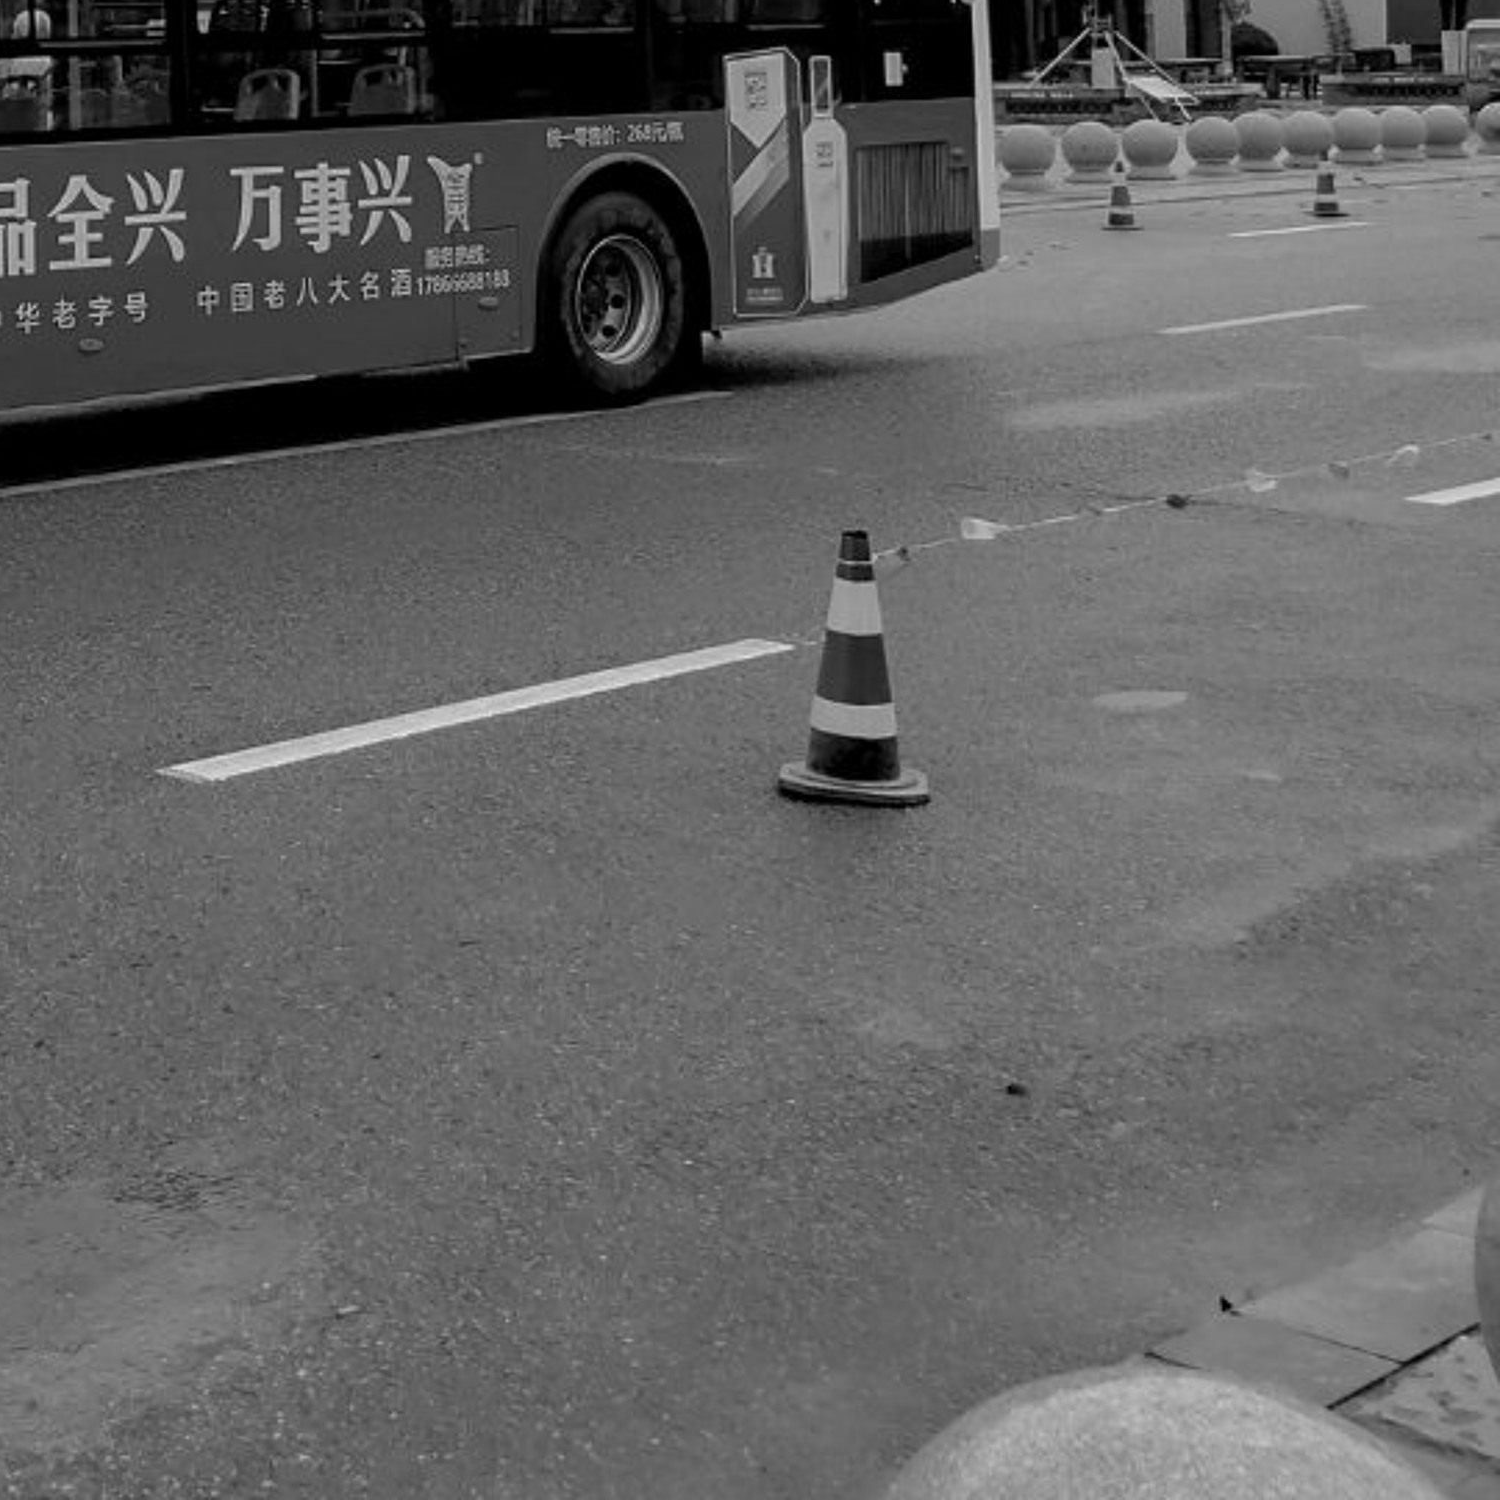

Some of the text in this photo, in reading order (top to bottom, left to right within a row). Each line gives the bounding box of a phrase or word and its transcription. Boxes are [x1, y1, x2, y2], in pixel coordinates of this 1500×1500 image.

[230, 154, 412, 254] 万事兴
[196, 269, 412, 315] 中国老八大名酒
